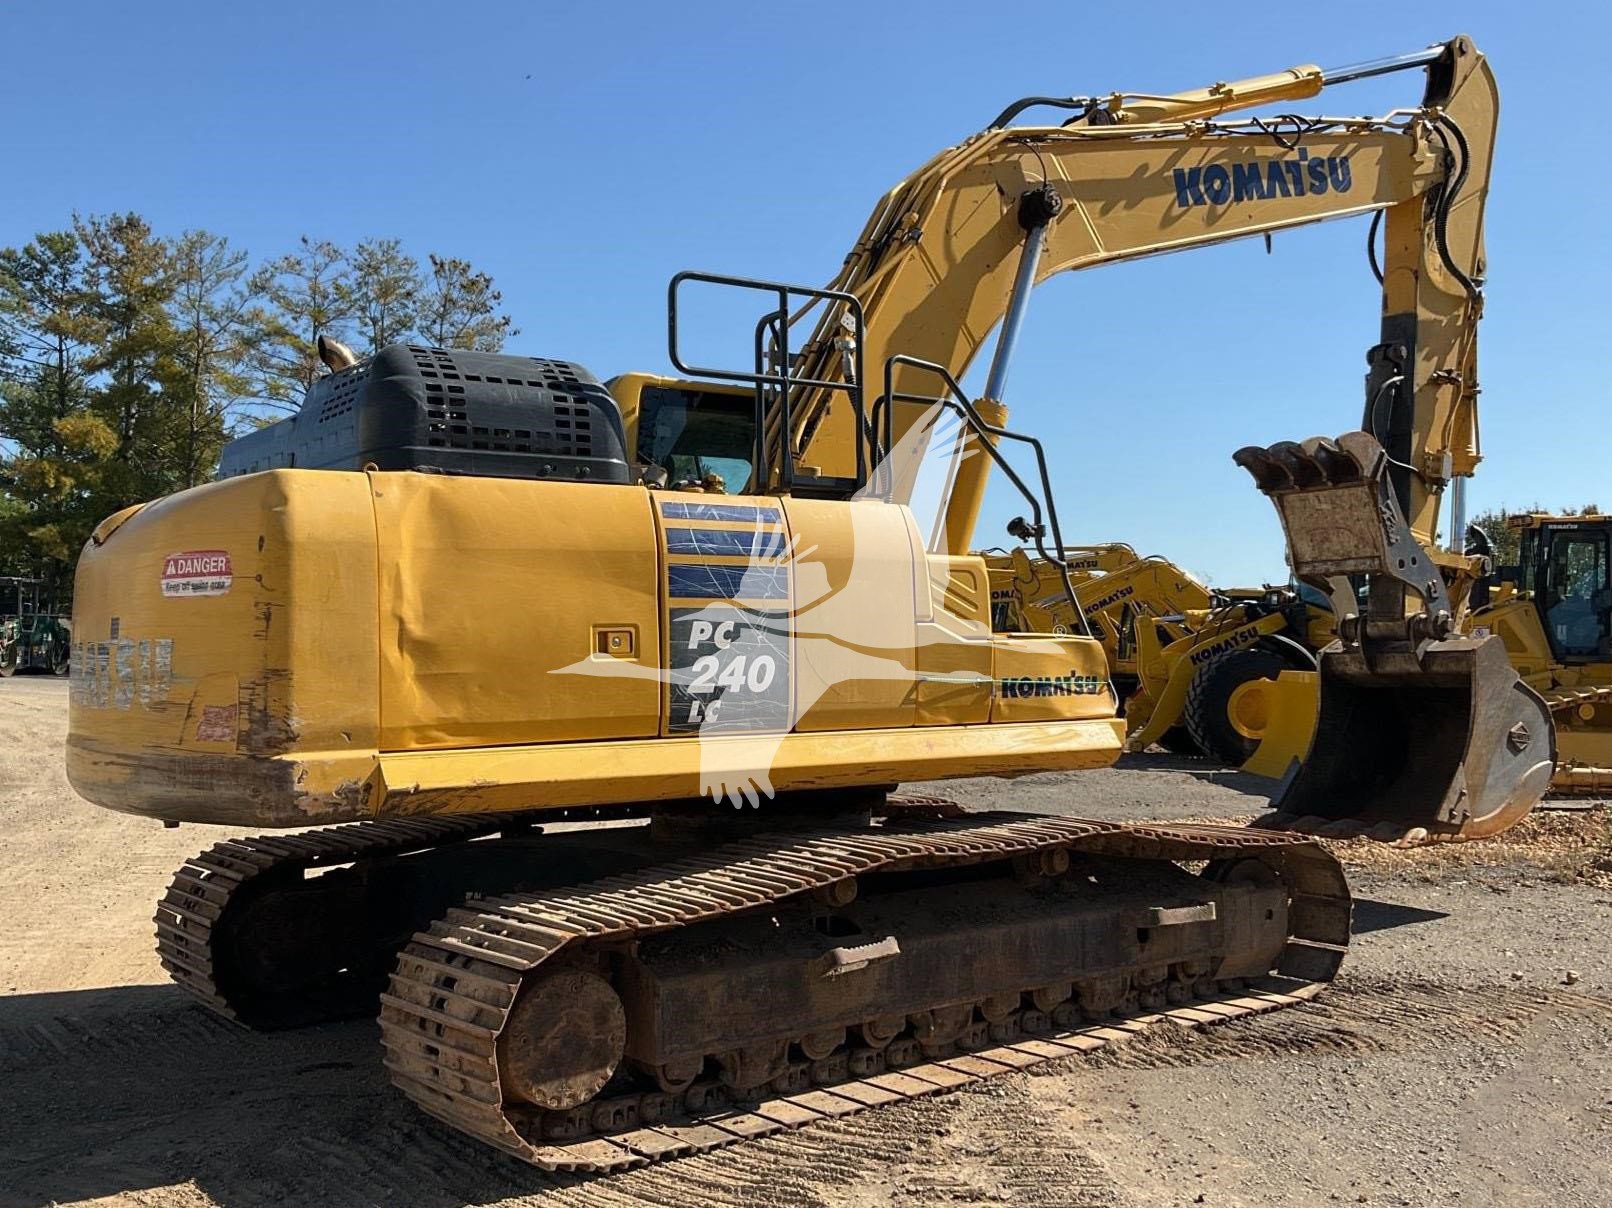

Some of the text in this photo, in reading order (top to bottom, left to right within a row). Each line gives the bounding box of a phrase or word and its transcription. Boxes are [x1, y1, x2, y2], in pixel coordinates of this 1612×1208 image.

[1173, 147, 1352, 208] KOMATSU
[177, 557, 226, 574] DANGER
[1084, 585, 1134, 615] KOMATSU
[688, 621, 735, 650] PC
[1190, 626, 1259, 666] KOMATSU
[687, 655, 776, 693] 240
[1001, 669, 1098, 699] KOMATSU
[687, 700, 722, 723] LC
